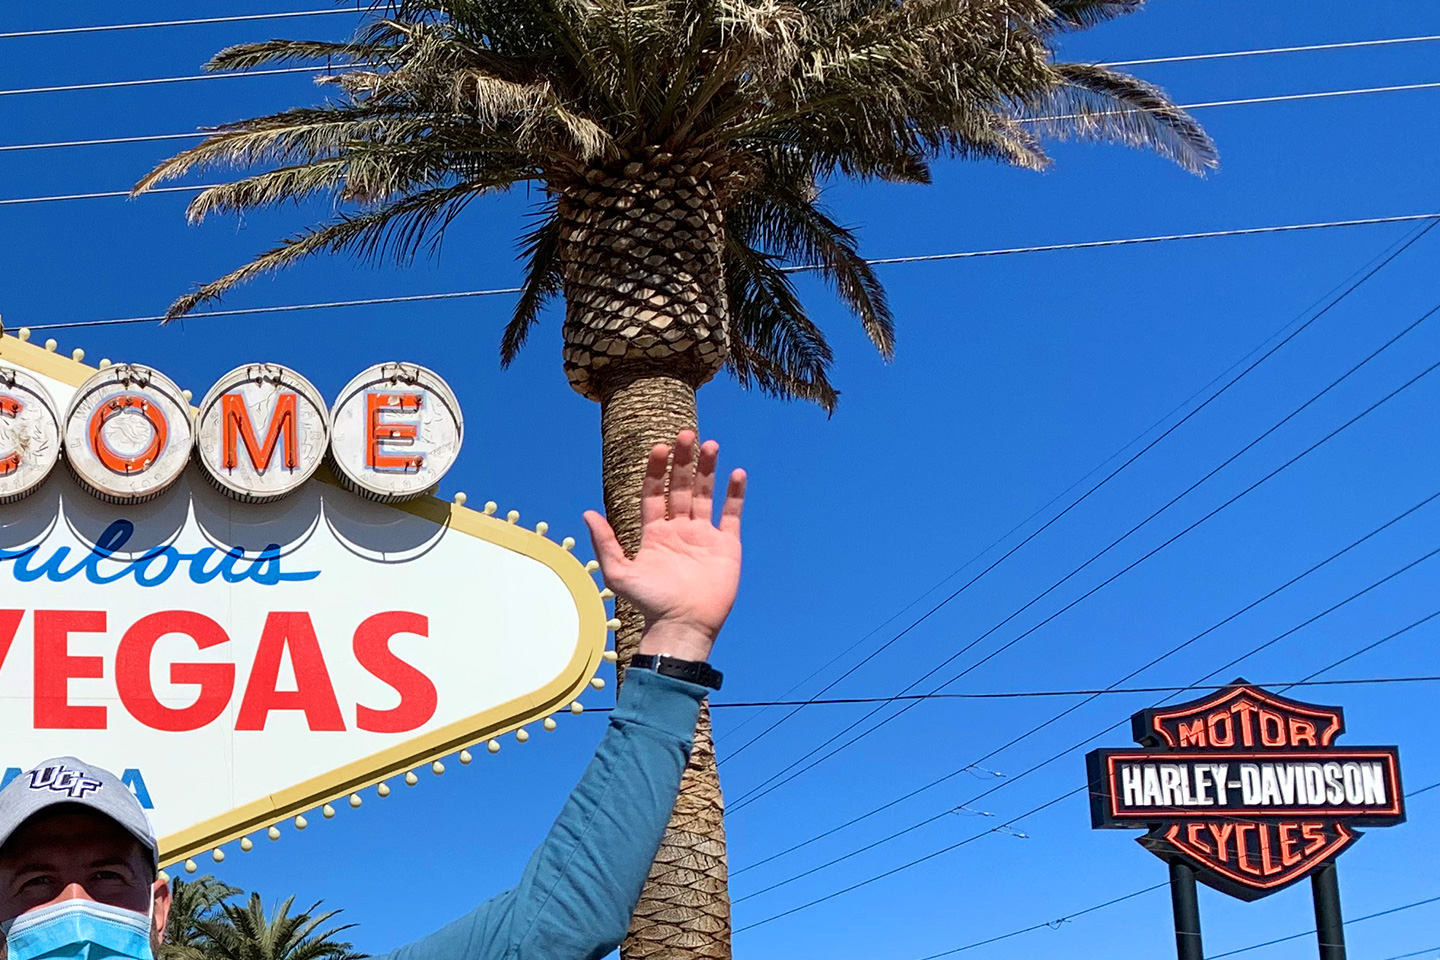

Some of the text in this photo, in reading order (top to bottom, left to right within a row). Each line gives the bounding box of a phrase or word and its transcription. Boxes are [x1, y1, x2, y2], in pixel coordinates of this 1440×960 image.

[1178, 699, 1318, 747] MOTOR
[25, 765, 103, 799] UCF
[1121, 762, 1386, 806] HARLEY-DAVIDSON
[1188, 823, 1326, 877] CYCLES
